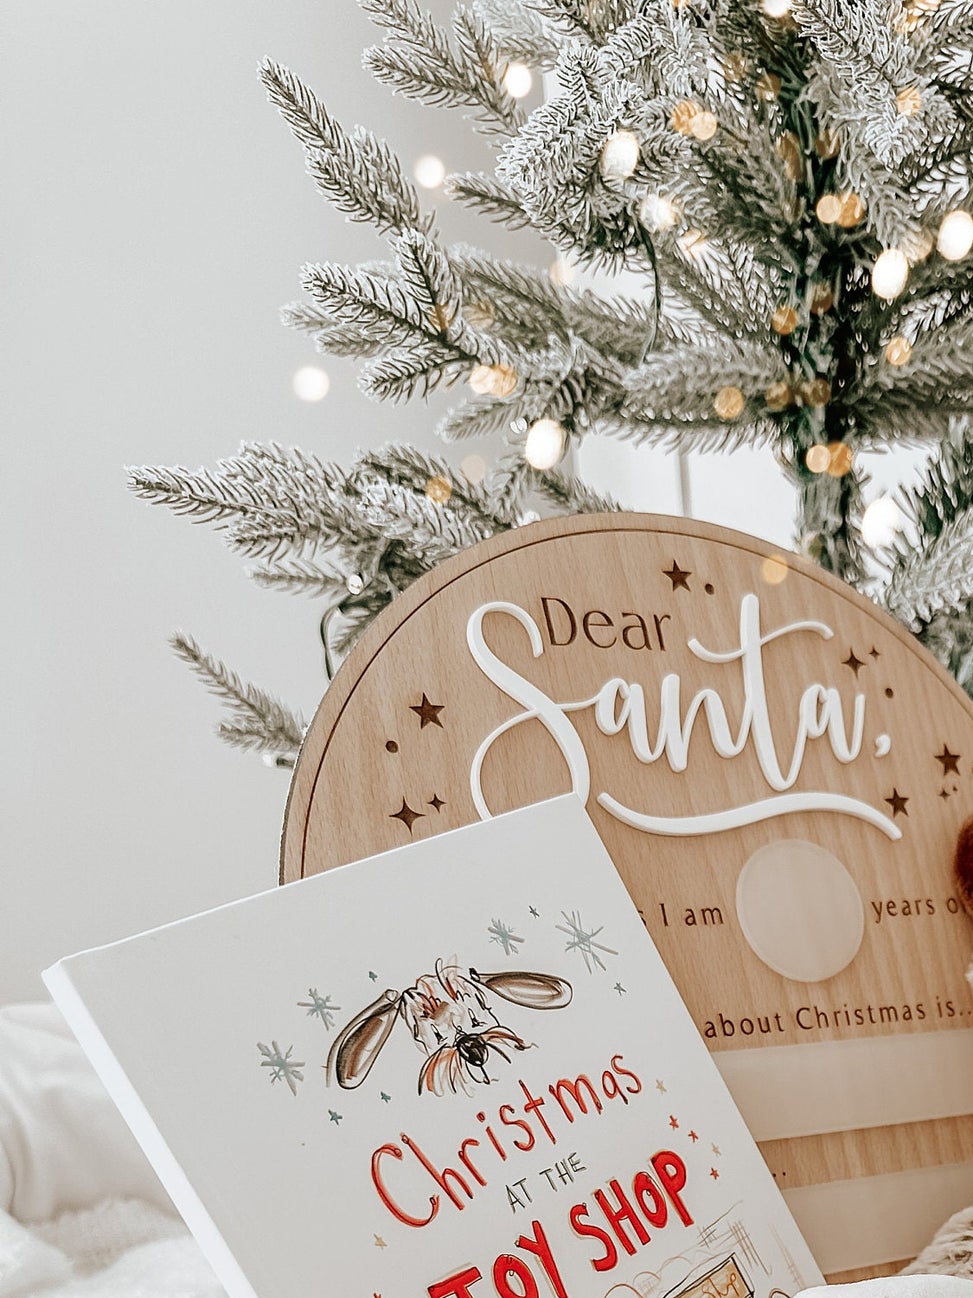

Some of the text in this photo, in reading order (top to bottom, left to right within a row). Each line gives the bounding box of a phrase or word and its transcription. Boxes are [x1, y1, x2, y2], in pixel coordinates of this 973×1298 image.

[541, 596, 671, 652] Dear
[466, 593, 892, 818] Santa,
[659, 902, 669, 927] I
[684, 906, 724, 927] am
[871, 897, 936, 924] years
[704, 1012, 785, 1039] about
[795, 1003, 926, 1030] Christmas
[371, 1054, 643, 1229] Christmas
[505, 1152, 588, 1214] AT THE
[568, 1150, 695, 1273] SHOP
